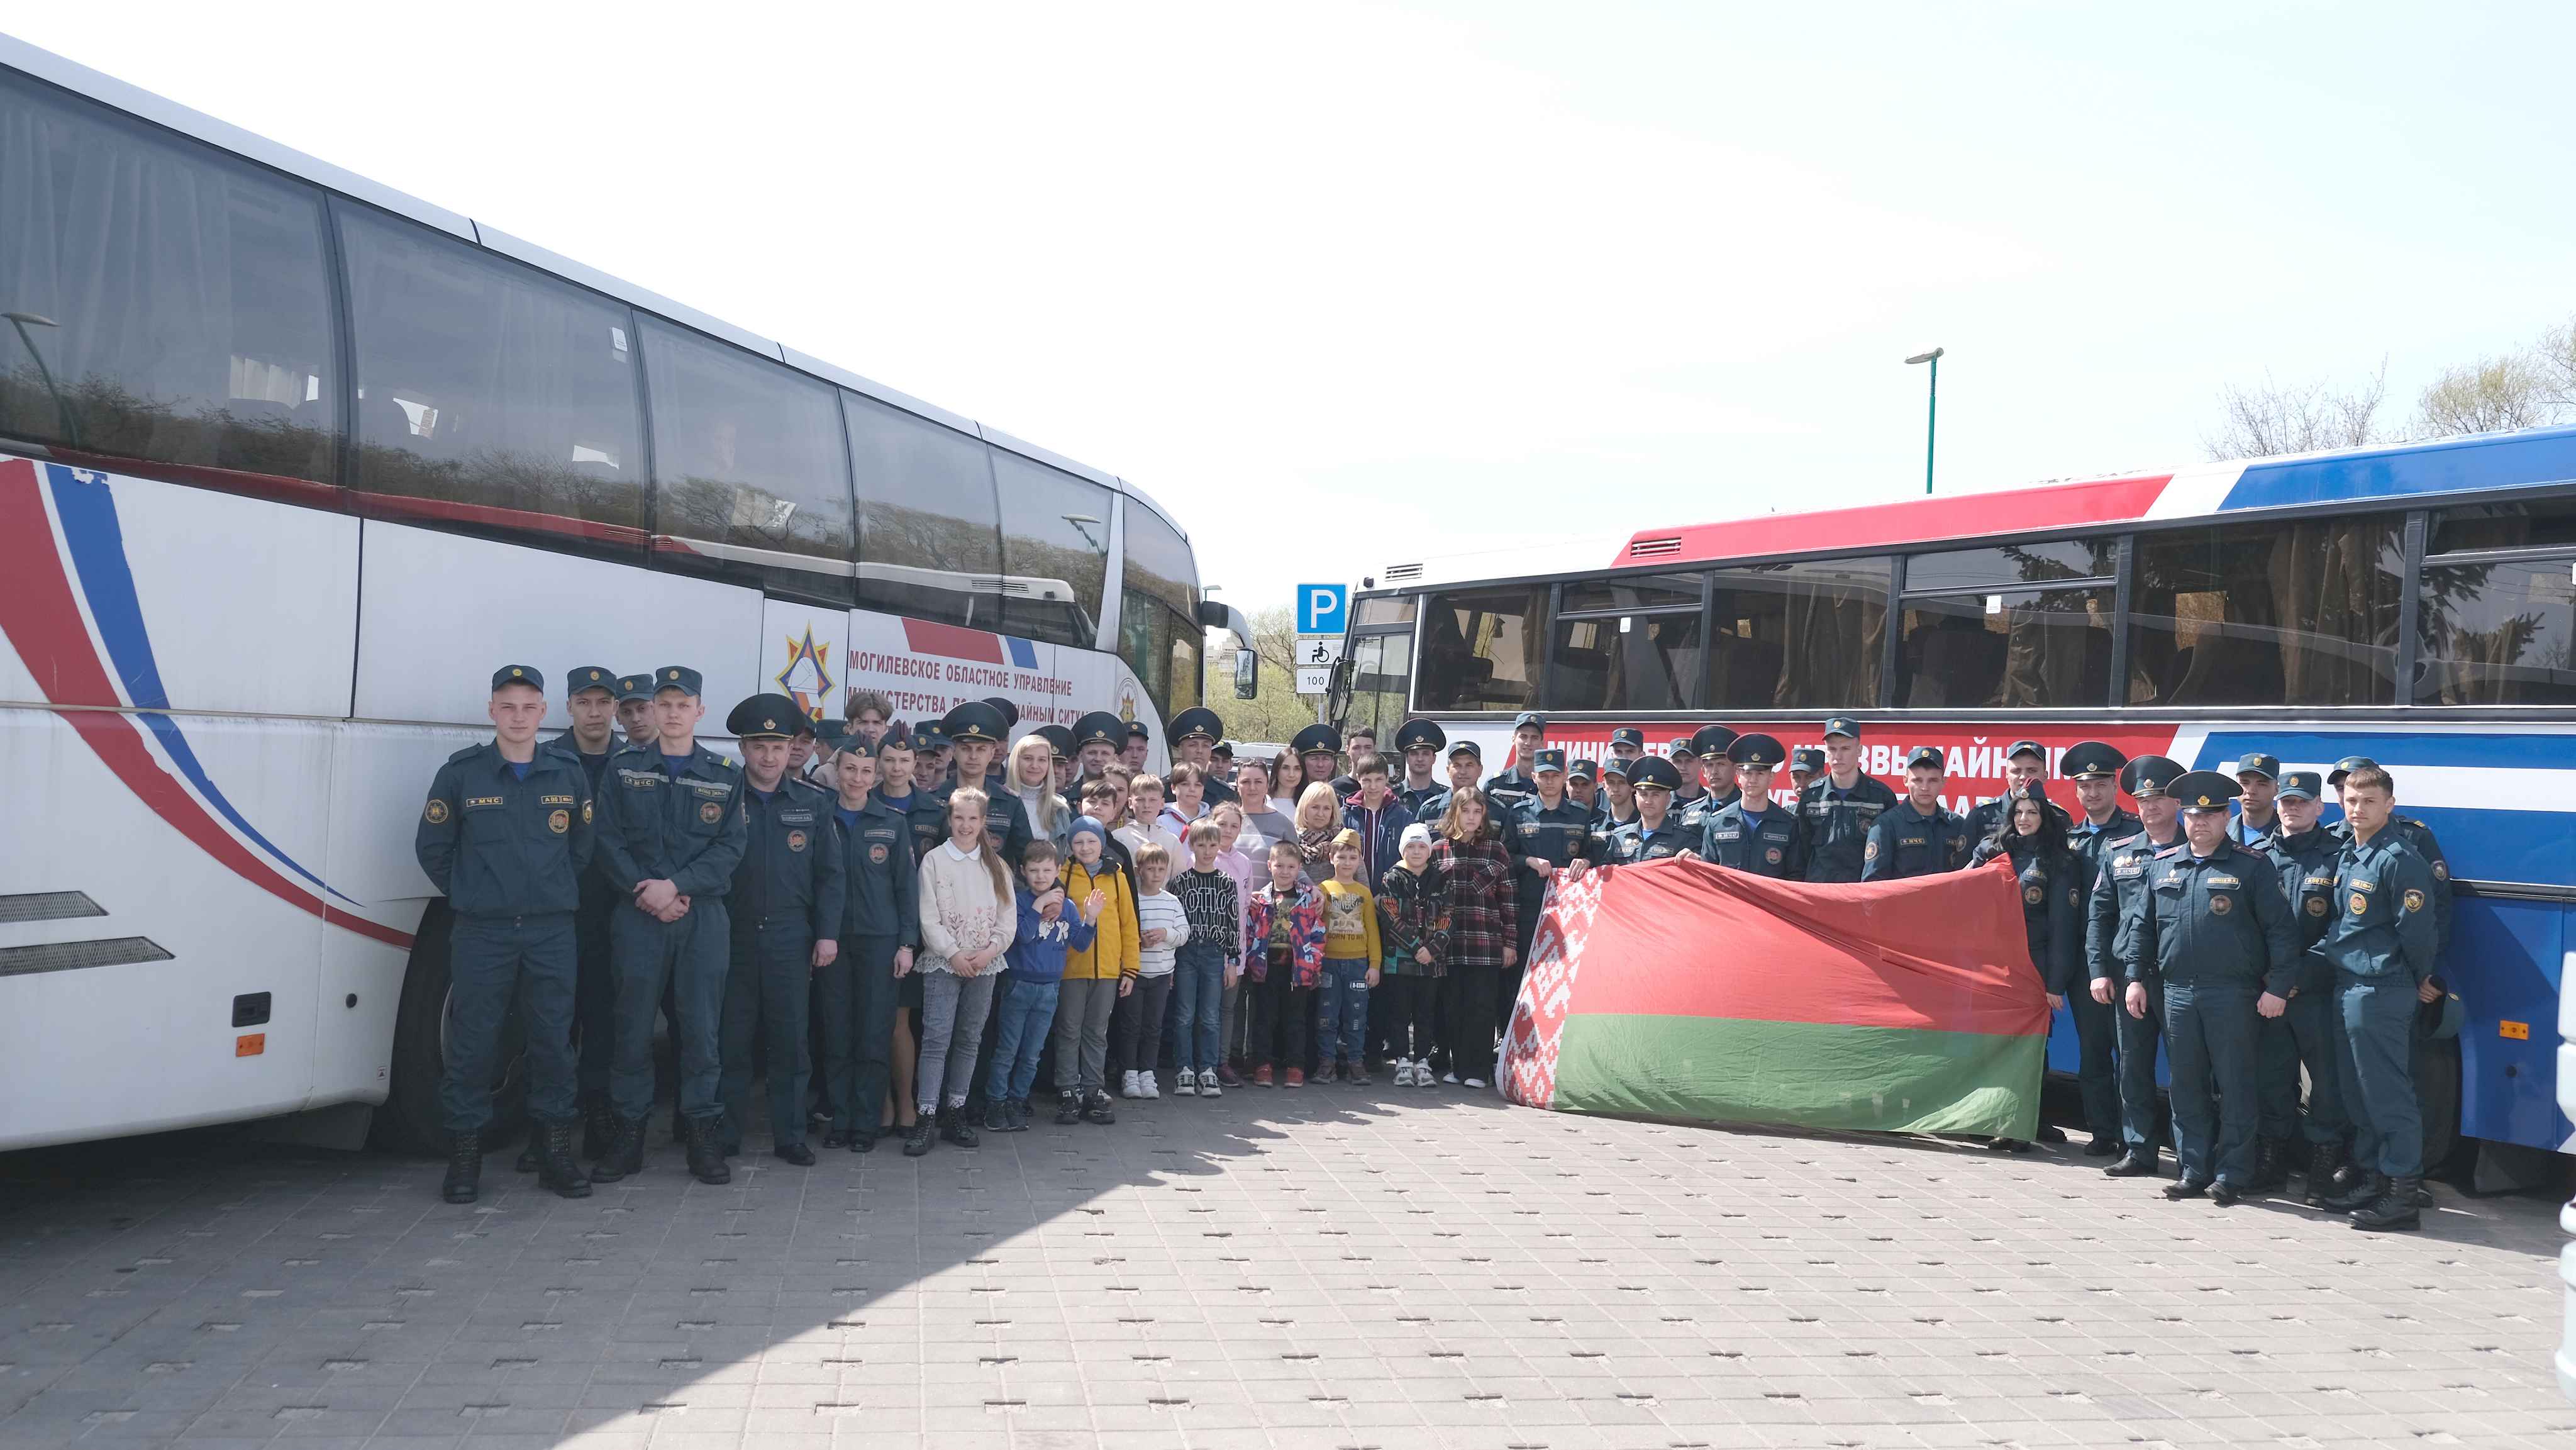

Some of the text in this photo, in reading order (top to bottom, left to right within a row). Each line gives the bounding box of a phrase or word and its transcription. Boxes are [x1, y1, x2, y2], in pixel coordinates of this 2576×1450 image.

[1311, 589, 1338, 628] P
[850, 650, 1072, 696] МОГИЛЕВСКОЕ ОБЛАСТНОЕ УПРАВЛЕНИЕ
[1307, 676, 1324, 685] 100
